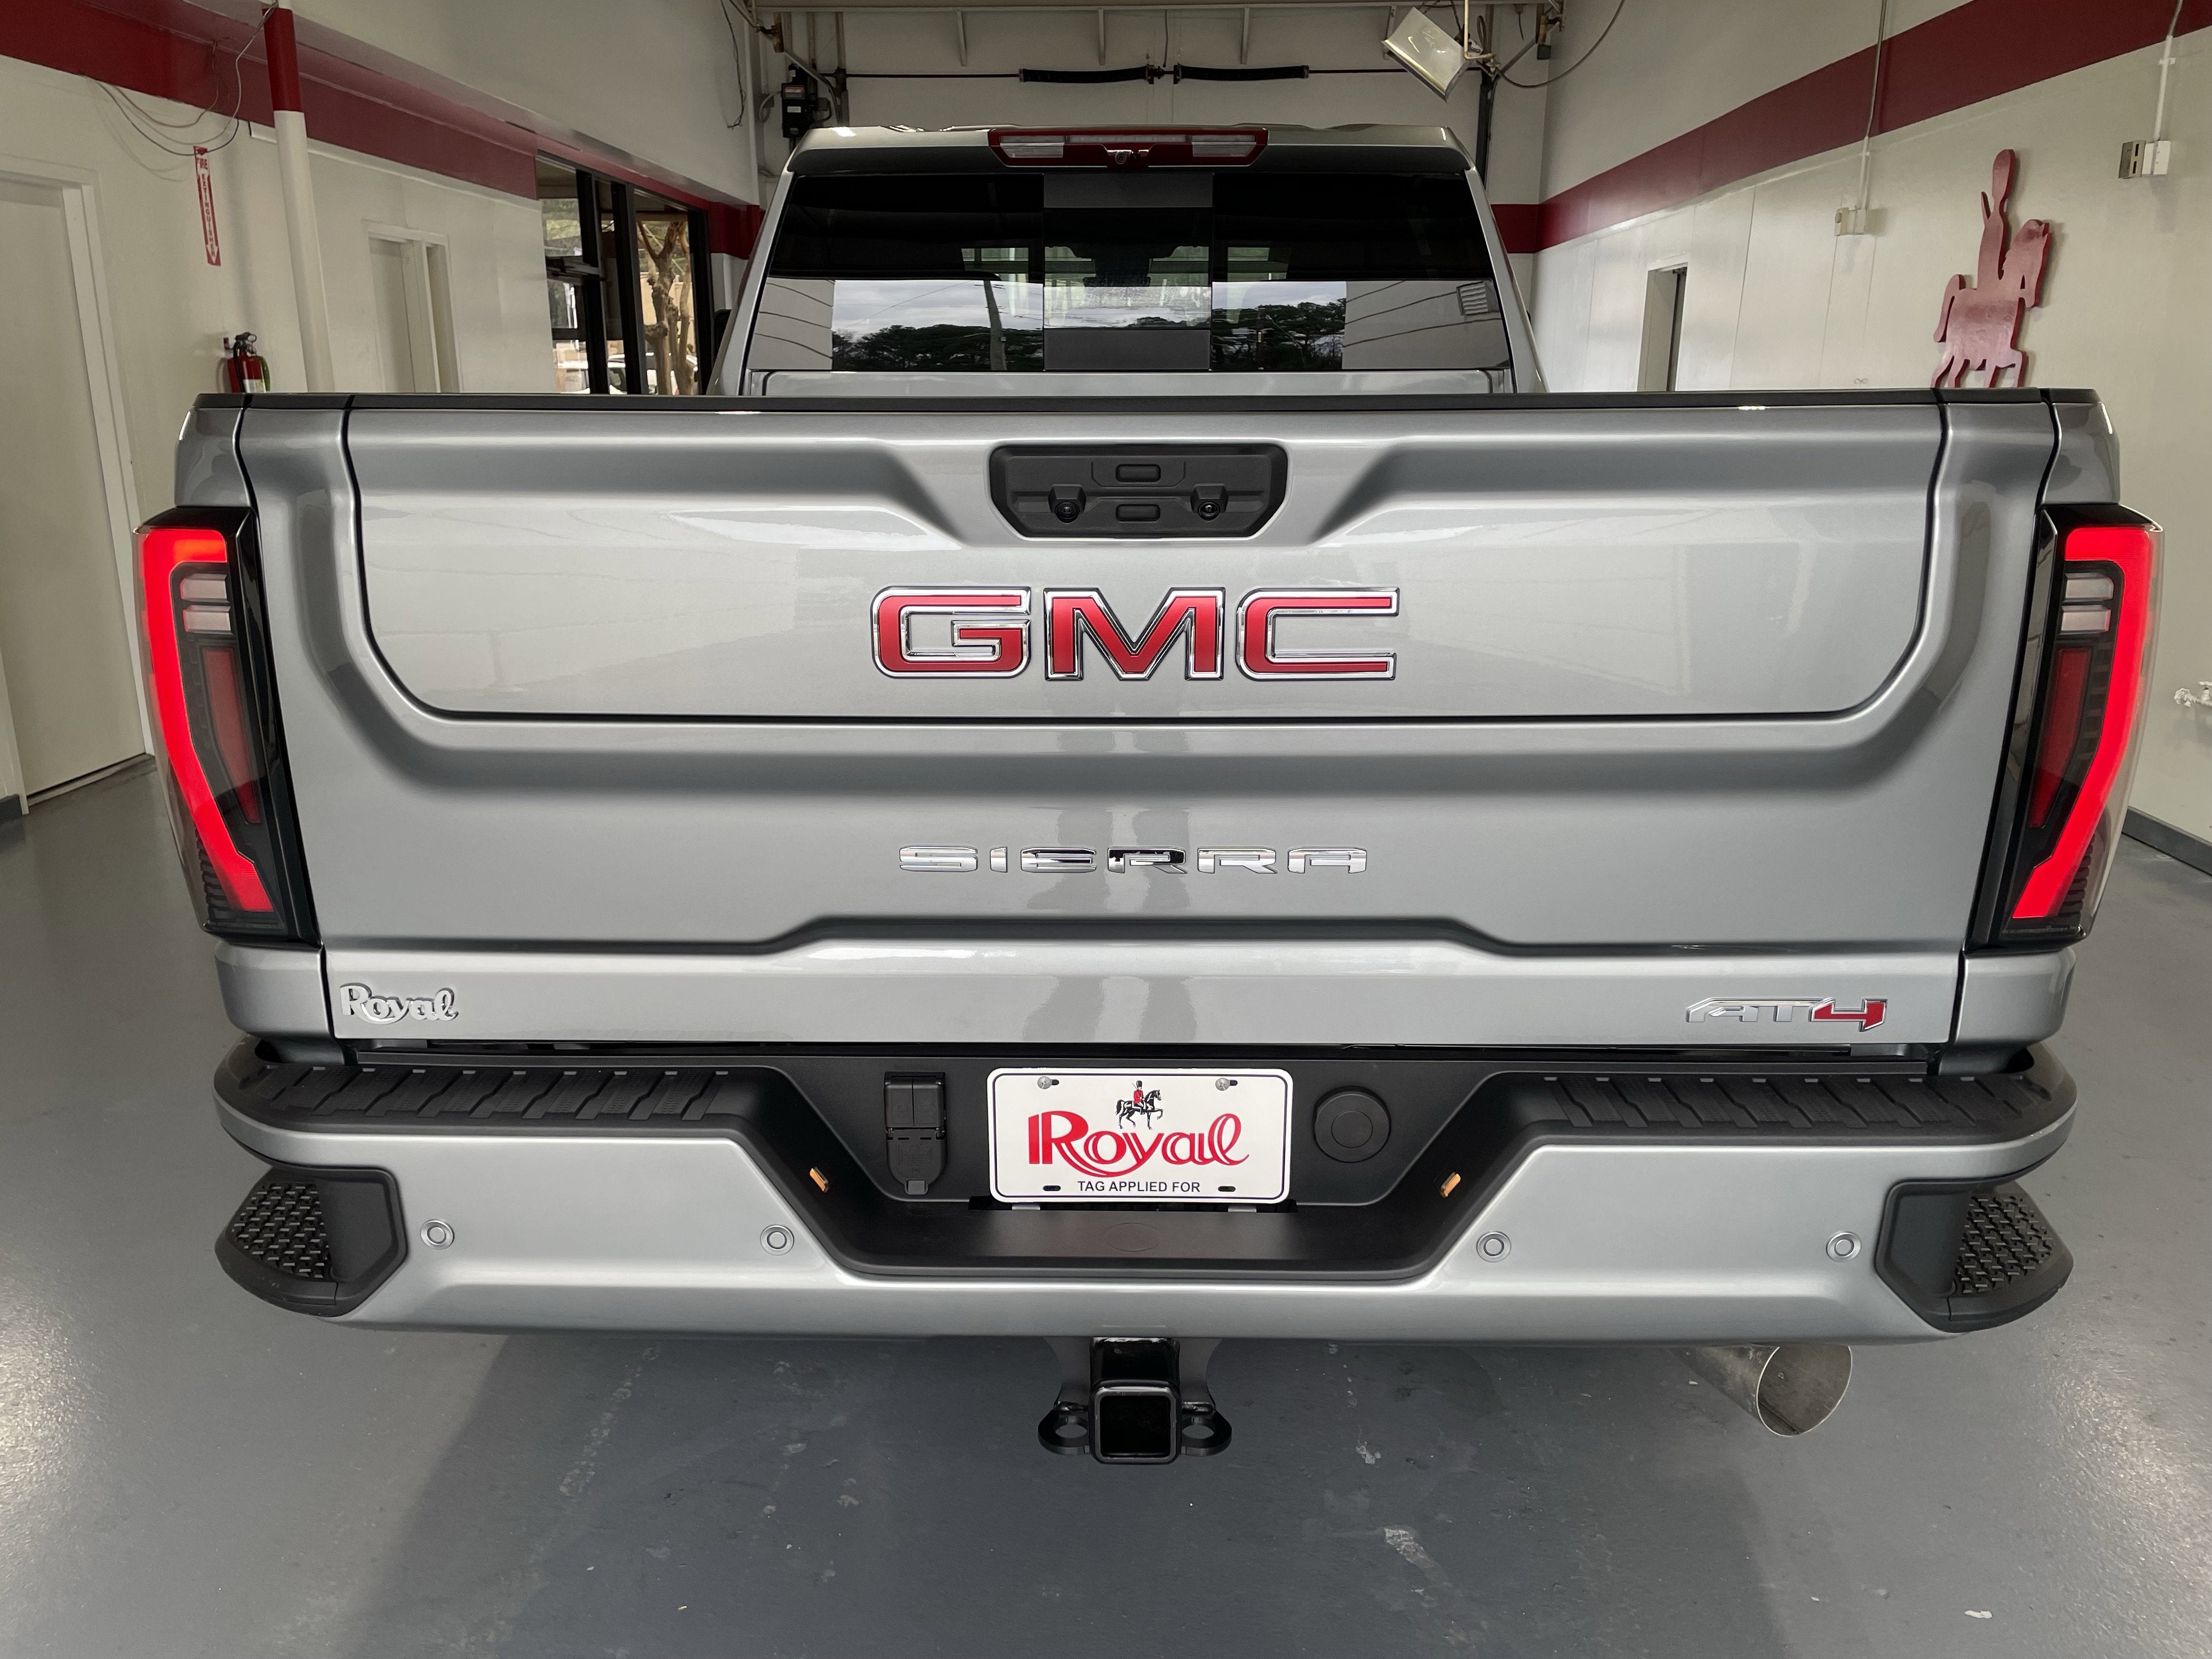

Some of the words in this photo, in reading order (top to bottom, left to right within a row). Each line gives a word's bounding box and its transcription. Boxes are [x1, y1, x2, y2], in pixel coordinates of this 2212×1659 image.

[871, 586, 1400, 681] GMC
[899, 844, 1367, 874] SIERRA
[340, 982, 459, 1025] Royal
[1686, 996, 1888, 1032] AT4
[1028, 1110, 1249, 1178] Royal
[1077, 1181, 1105, 1192] TAG
[1109, 1181, 1168, 1192] APPLIED
[1172, 1182, 1201, 1193] FOR
